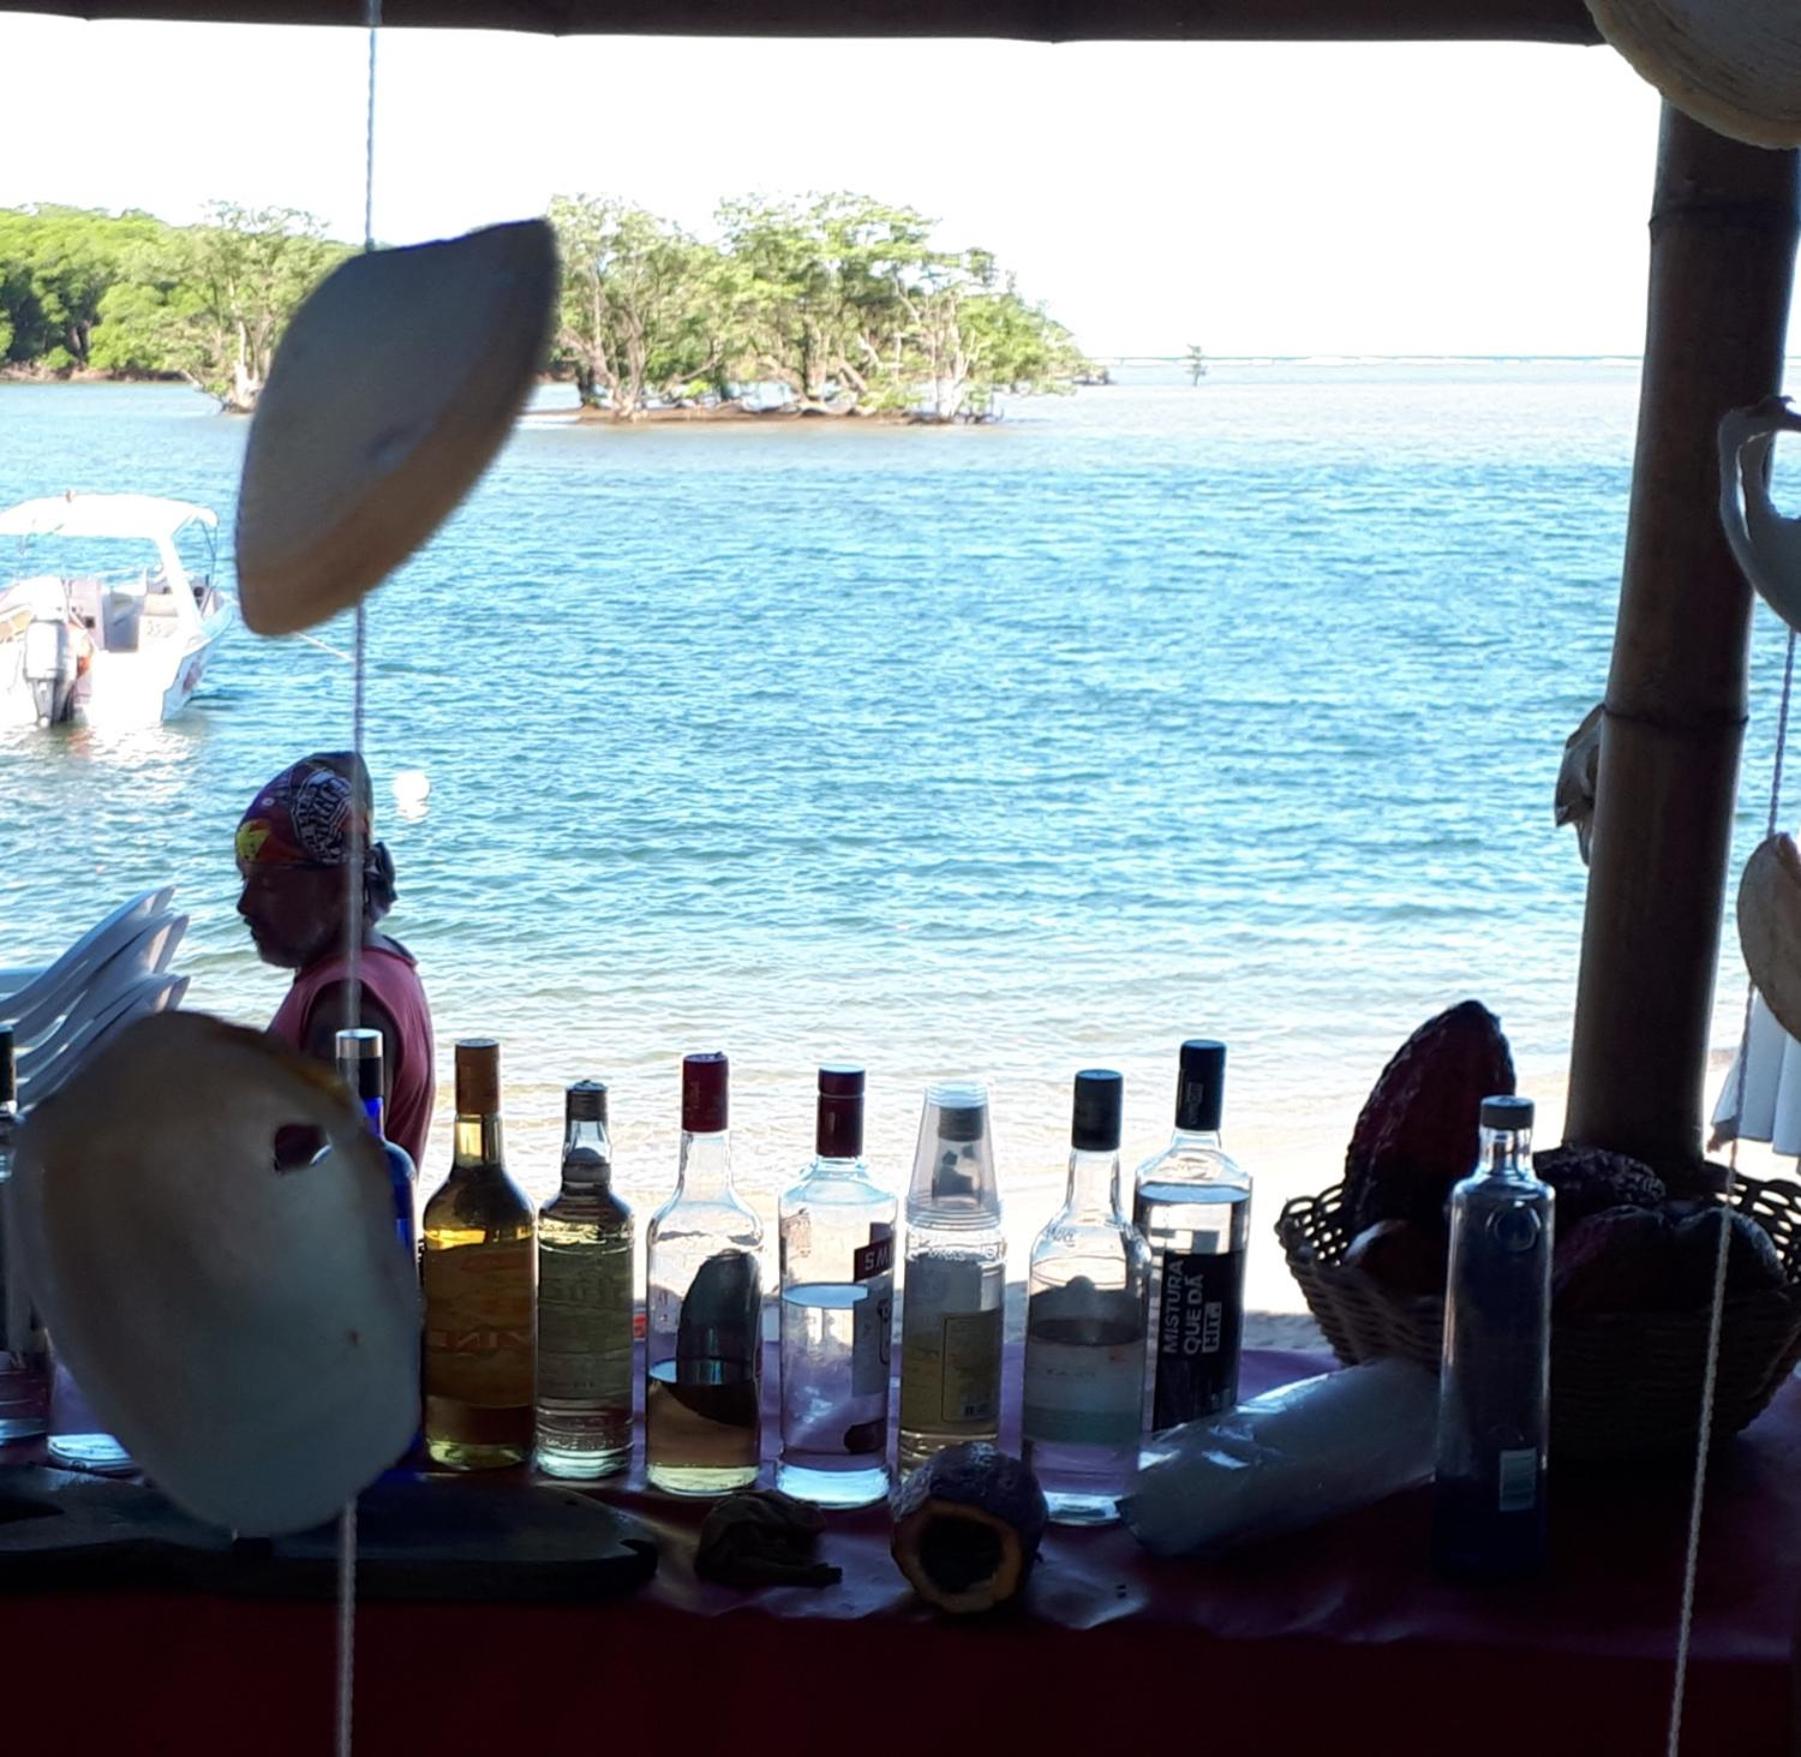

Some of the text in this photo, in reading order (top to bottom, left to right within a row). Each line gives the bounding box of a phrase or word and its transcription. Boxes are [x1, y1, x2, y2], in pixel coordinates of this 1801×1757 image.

[1163, 1259, 1184, 1353] MISTURA
[1184, 1274, 1204, 1355] QUE DÁ
